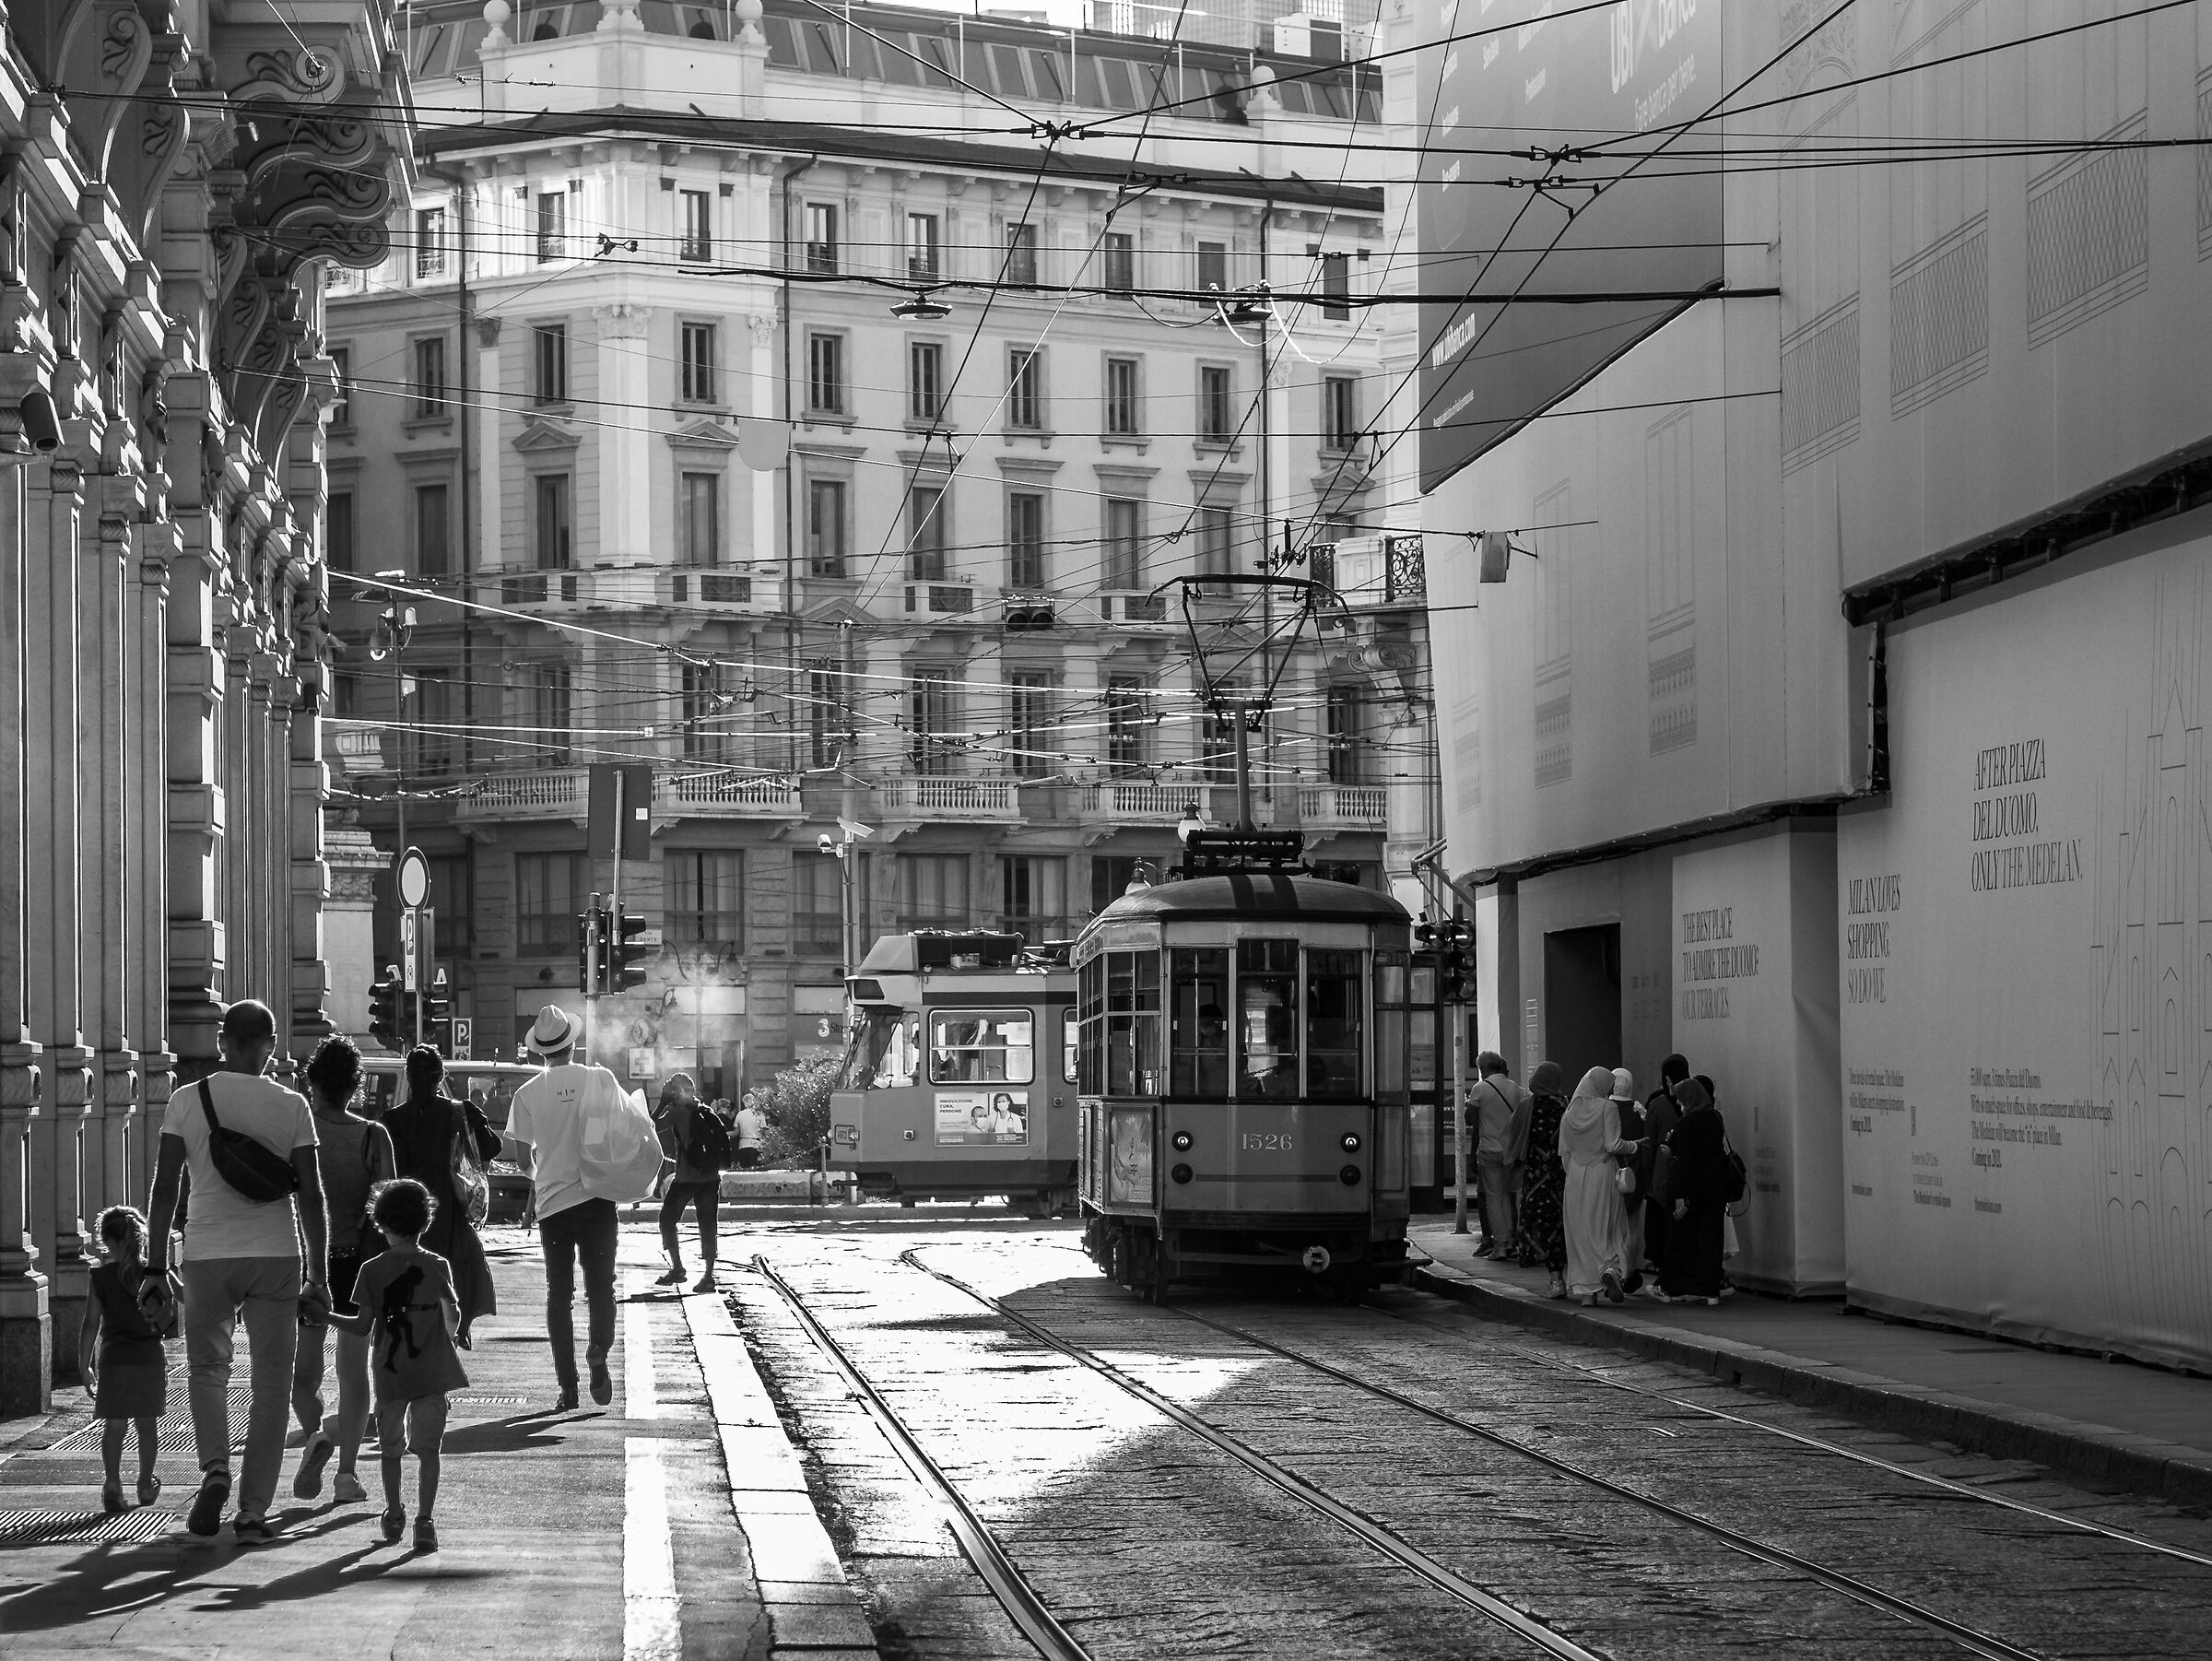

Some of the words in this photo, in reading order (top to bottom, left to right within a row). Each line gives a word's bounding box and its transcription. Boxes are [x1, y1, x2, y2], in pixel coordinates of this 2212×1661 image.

[1610, 0, 1633, 94] UBI
[1973, 747, 2006, 791] AFTER
[2008, 738, 2046, 783] PIAZZA
[1972, 800, 1994, 841] DEL
[1995, 792, 2039, 838] DUOMO.
[1971, 850, 2000, 891] ONLY
[2002, 846, 2025, 889] THE
[2026, 839, 2083, 886] MEDELAN.
[1848, 877, 1876, 914] MILAN
[1877, 874, 1901, 912] LOVES
[1683, 913, 1696, 944] THE
[1696, 910, 1712, 942] BEST
[1712, 907, 1733, 940] PLACE
[1683, 952, 1691, 982] TO
[1691, 949, 1716, 981] ADMIRE
[1717, 948, 1731, 979] THE
[1848, 969, 1858, 1003] SO
[1859, 968, 1872, 1003] DO
[1683, 989, 1696, 1020] OUR
[818, 1019, 830, 1038] 3
[1242, 1133, 1292, 1150] 1526
